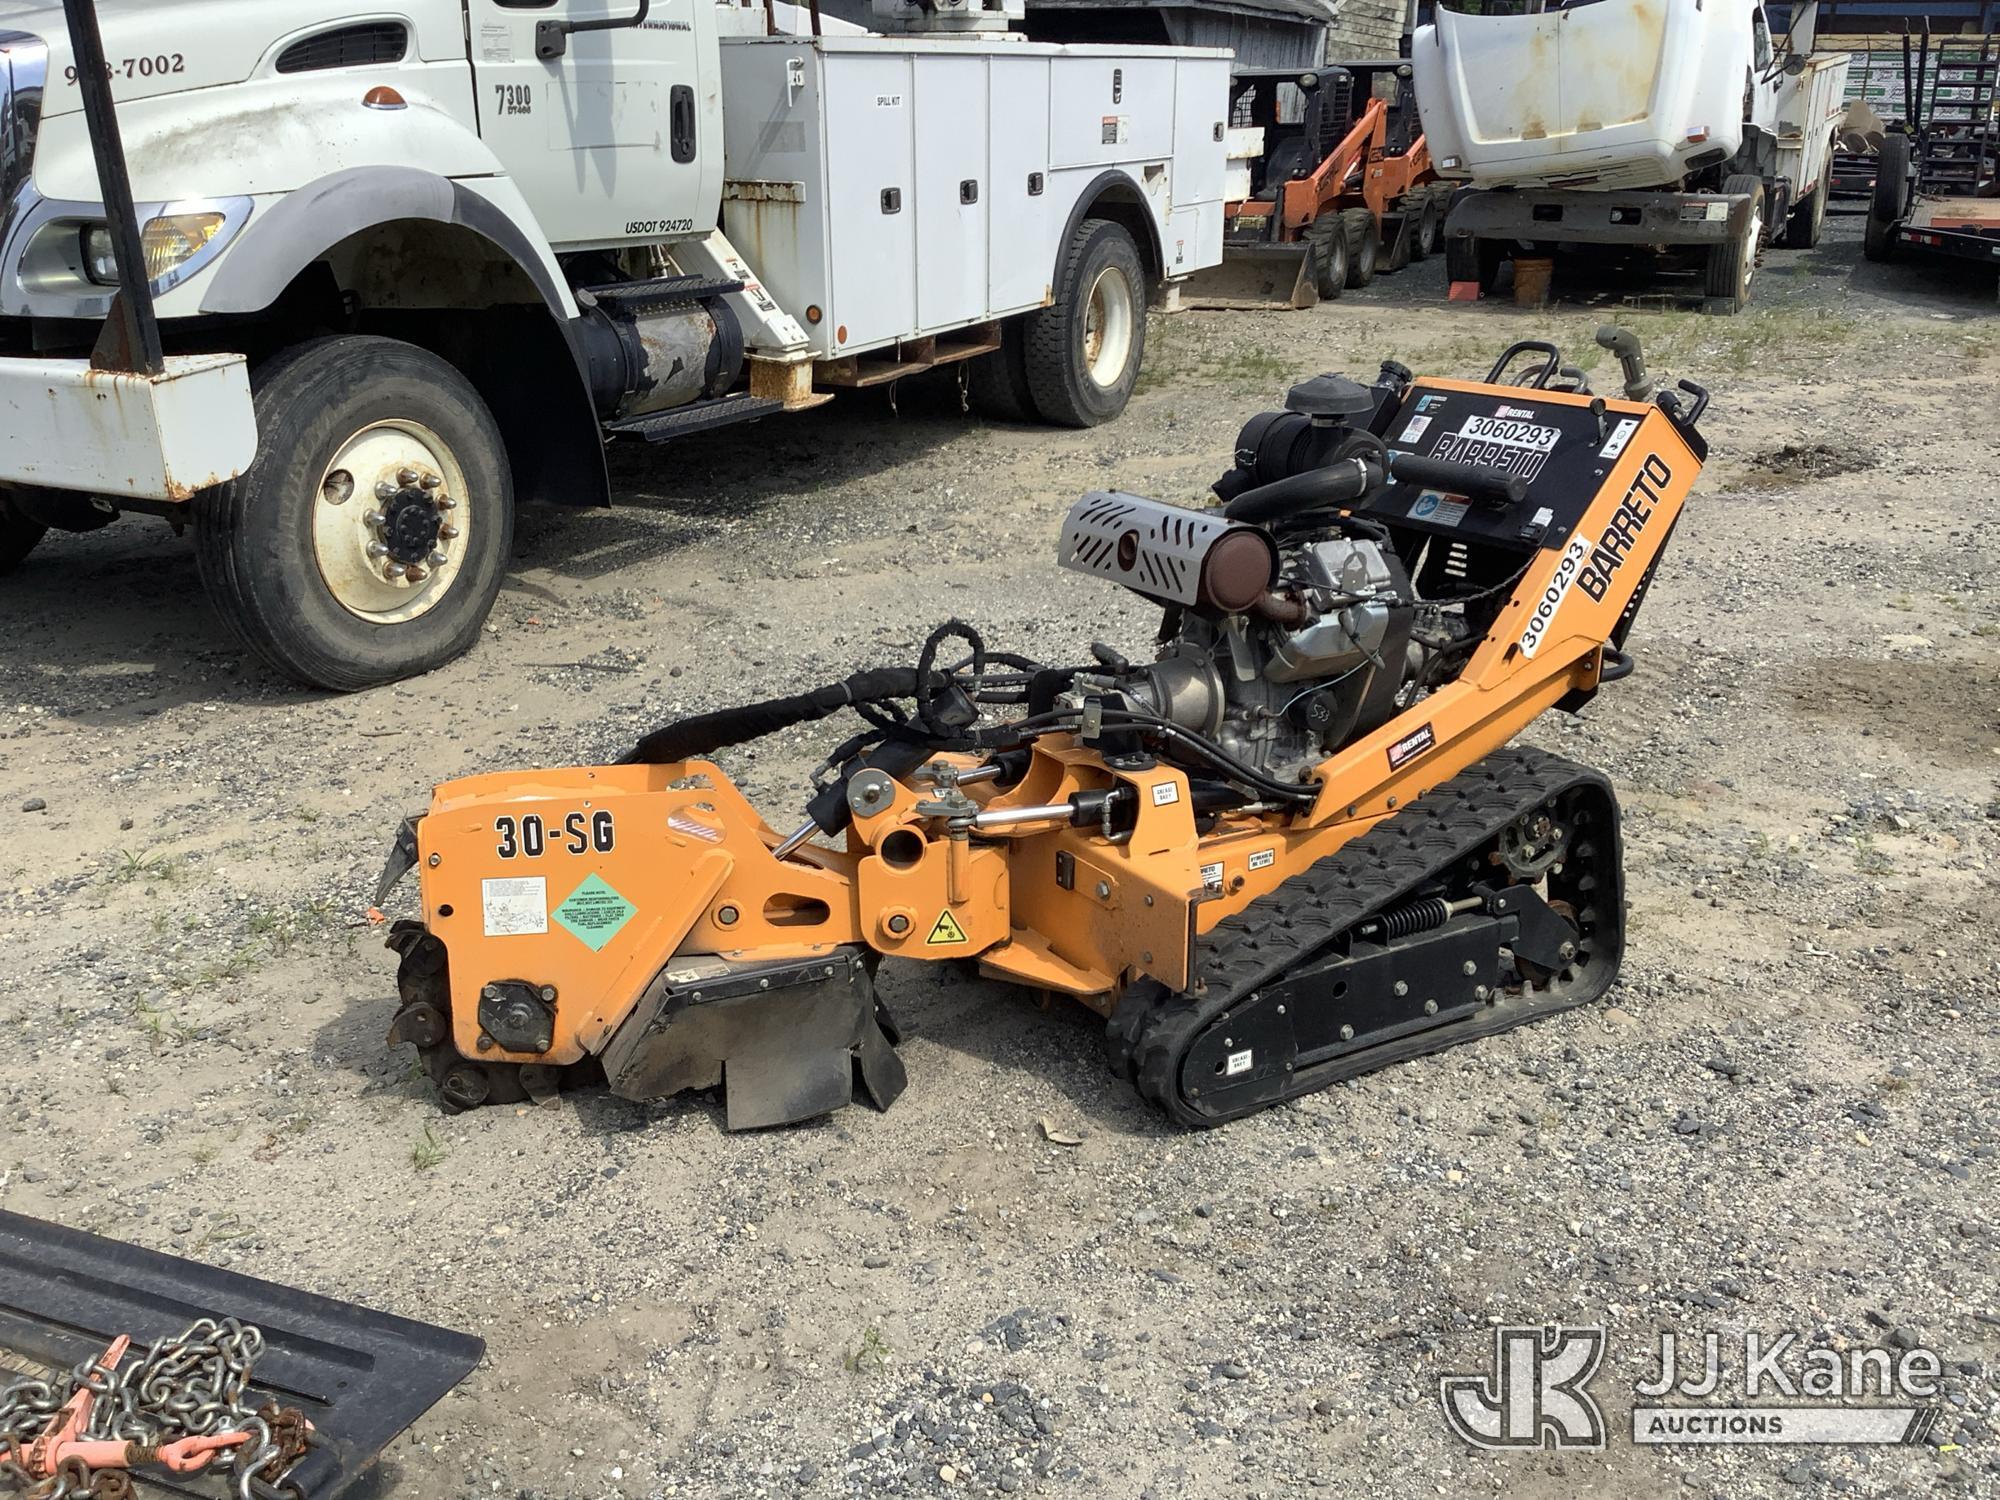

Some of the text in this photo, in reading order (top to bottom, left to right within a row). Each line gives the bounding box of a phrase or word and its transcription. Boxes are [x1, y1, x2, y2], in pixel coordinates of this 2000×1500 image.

[495, 84, 531, 115] 7300
[625, 218, 693, 234] USDOT 924720
[1507, 408, 1535, 419] RENTAL
[1469, 418, 1555, 446] 3060293
[1576, 453, 1672, 603] BARRETO
[1521, 541, 1584, 649] 3060293
[1401, 729, 1432, 753] RENTAL
[494, 809, 615, 860] 30-SG
